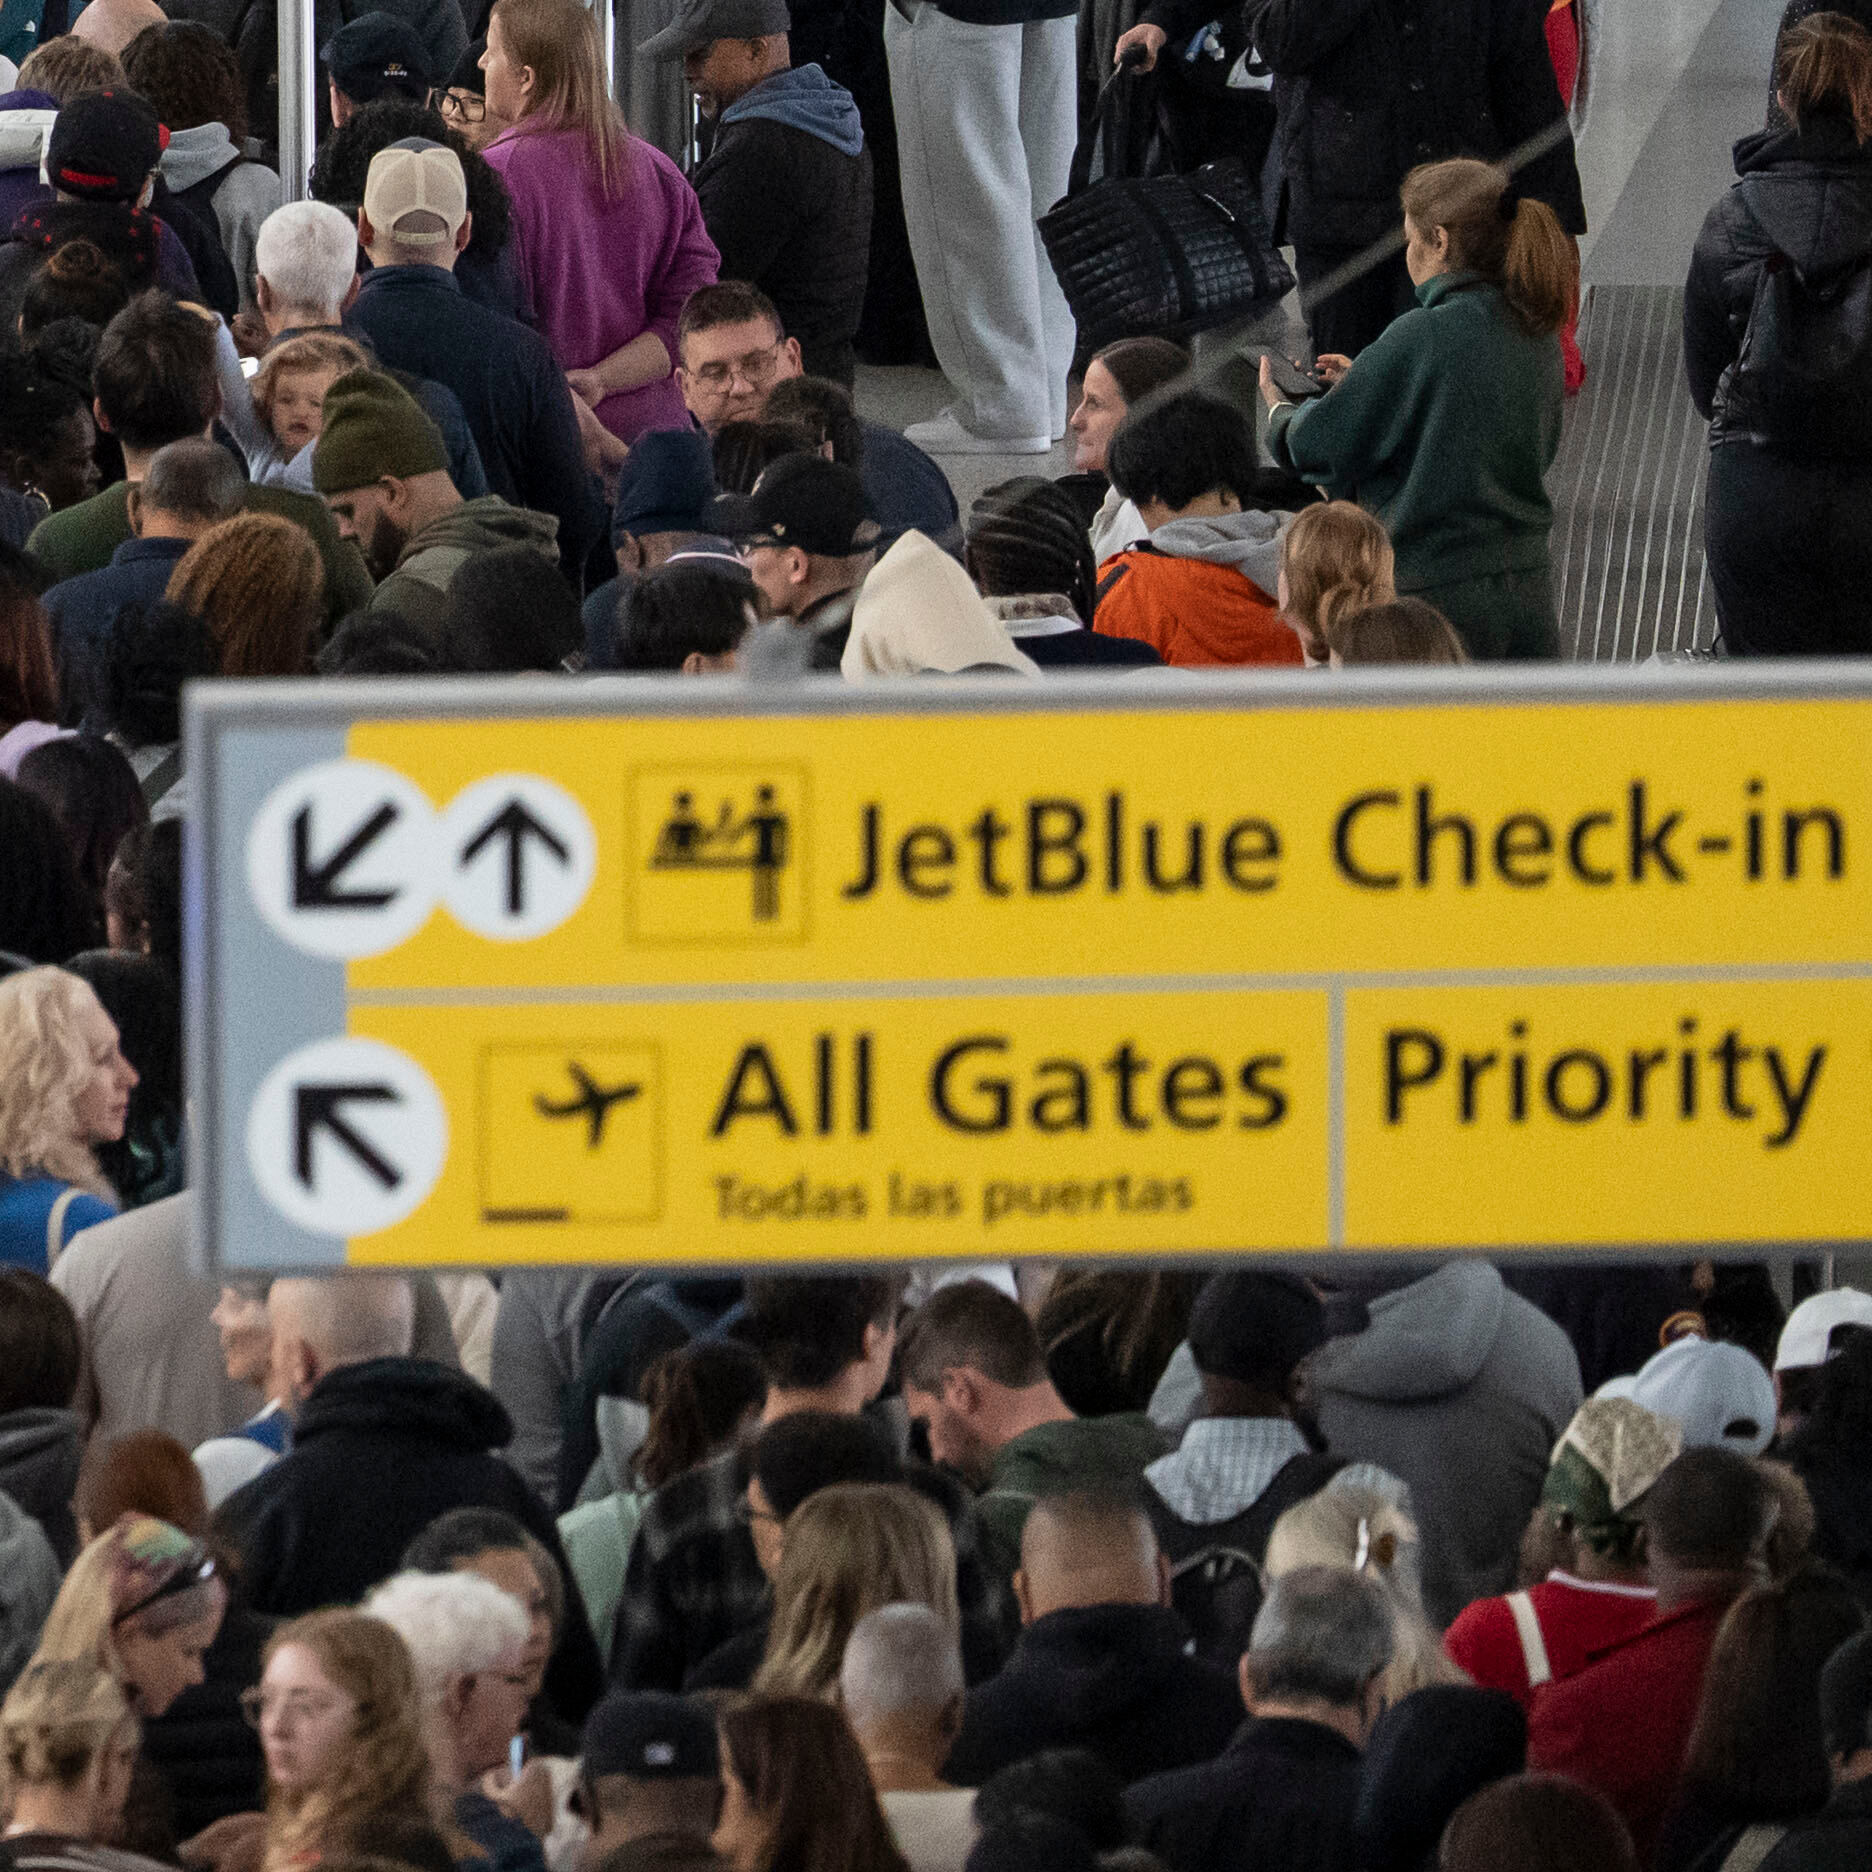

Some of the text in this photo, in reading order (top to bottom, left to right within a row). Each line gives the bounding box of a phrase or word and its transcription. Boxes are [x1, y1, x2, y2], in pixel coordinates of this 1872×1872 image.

[844, 779, 1845, 899] JetBlue Check-in
[711, 1034, 1288, 1137] All Gates
[1384, 1019, 1826, 1149] Priority
[715, 1173, 1195, 1226] Todas las puertas
